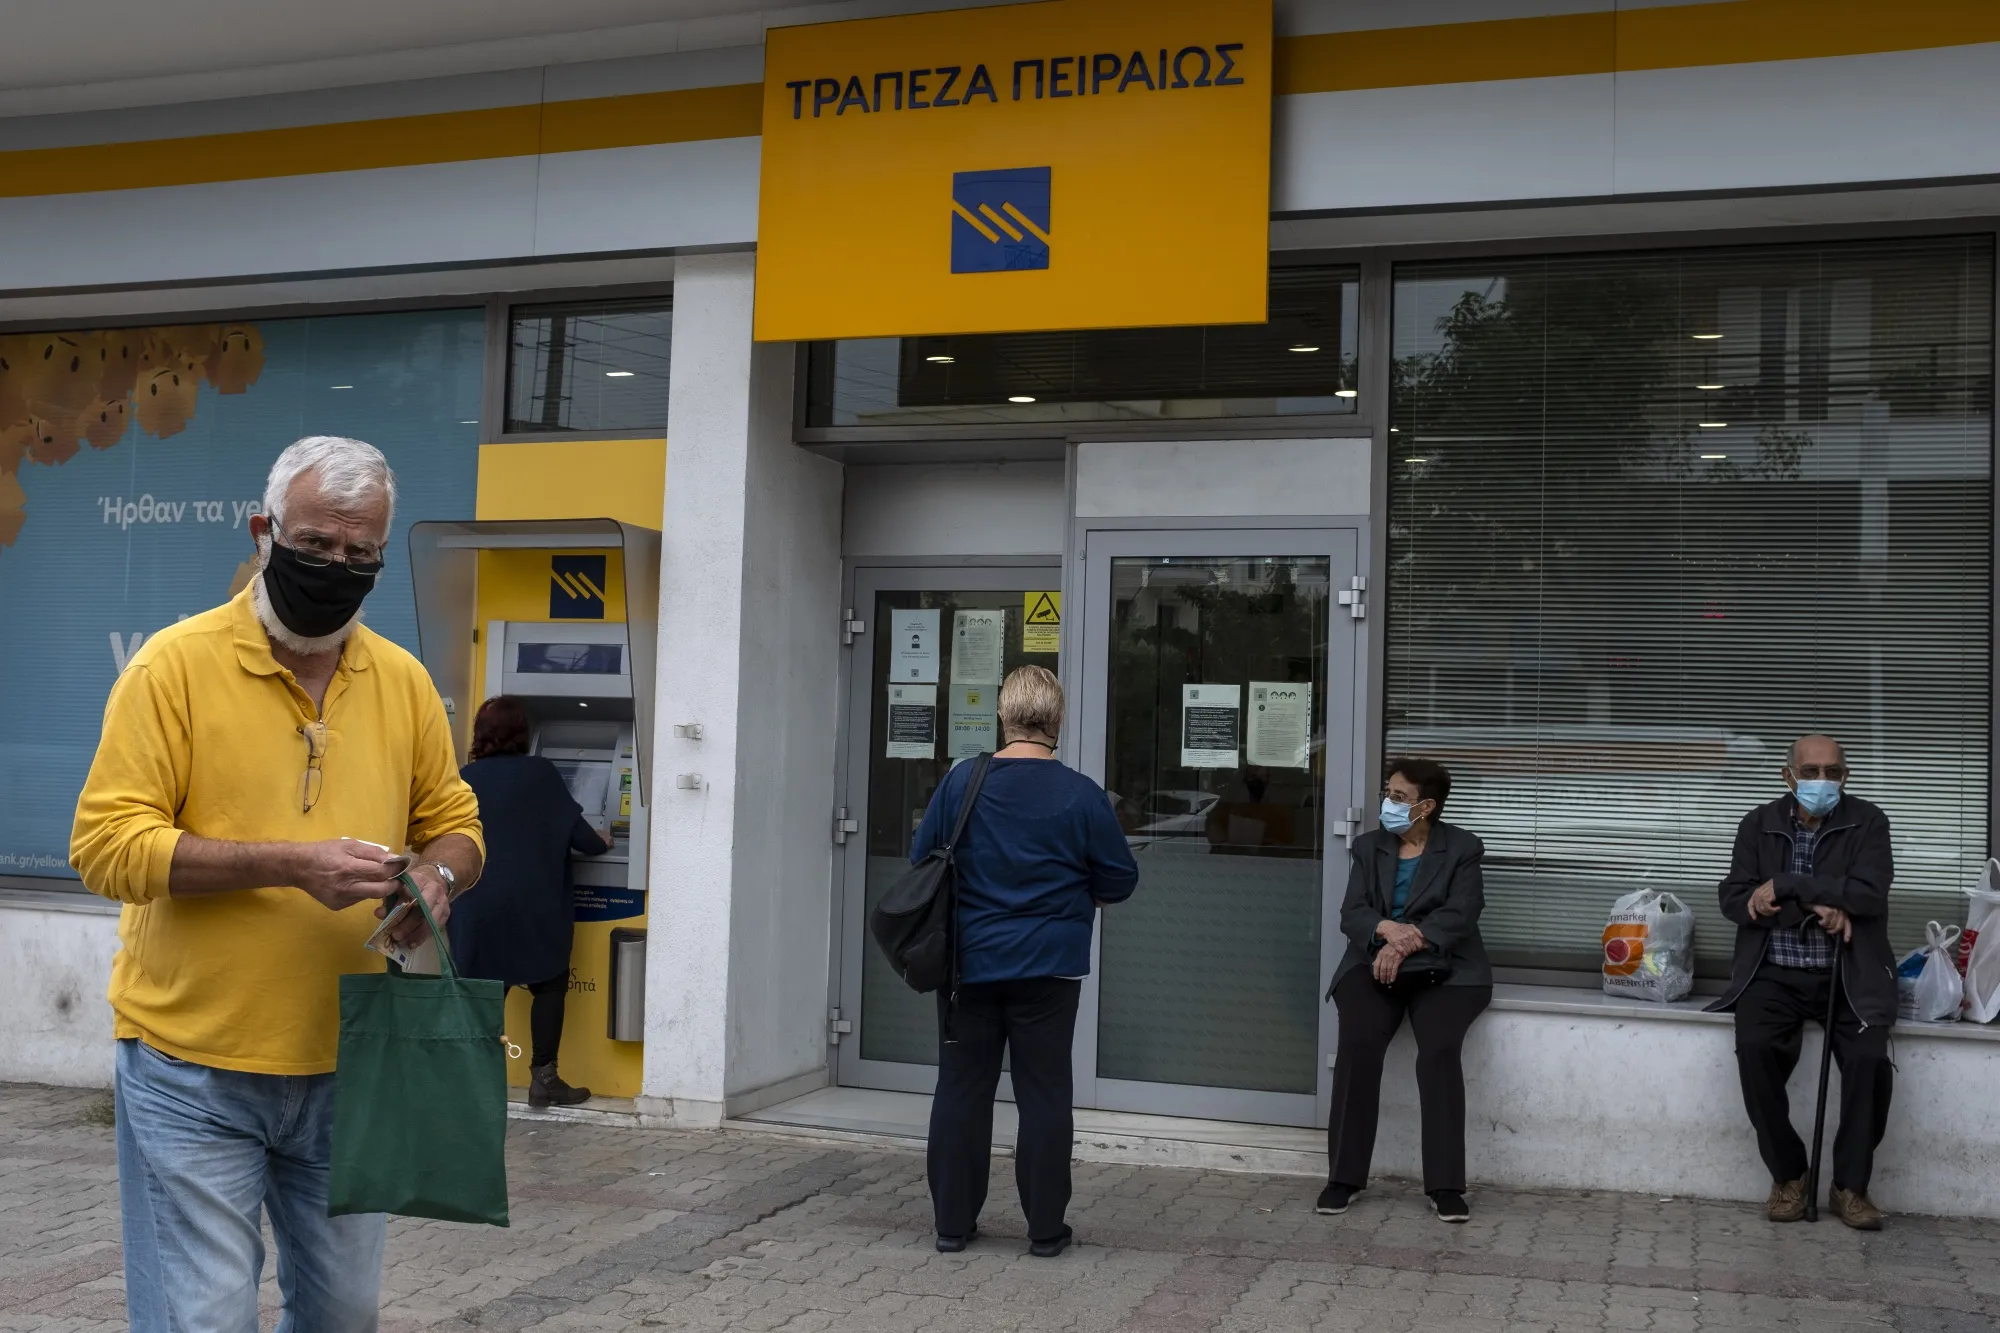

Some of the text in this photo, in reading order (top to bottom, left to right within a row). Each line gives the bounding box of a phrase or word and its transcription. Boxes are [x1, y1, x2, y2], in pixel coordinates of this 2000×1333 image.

[786, 43, 1245, 120] ΤΡΑΠΕΖΑ ΠΕΙΡΑΙΩΣ
[97, 493, 262, 531] Ήρθαν τα ye
[1608, 912, 1647, 922] rmarket
[567, 978, 597, 994] ρητά
